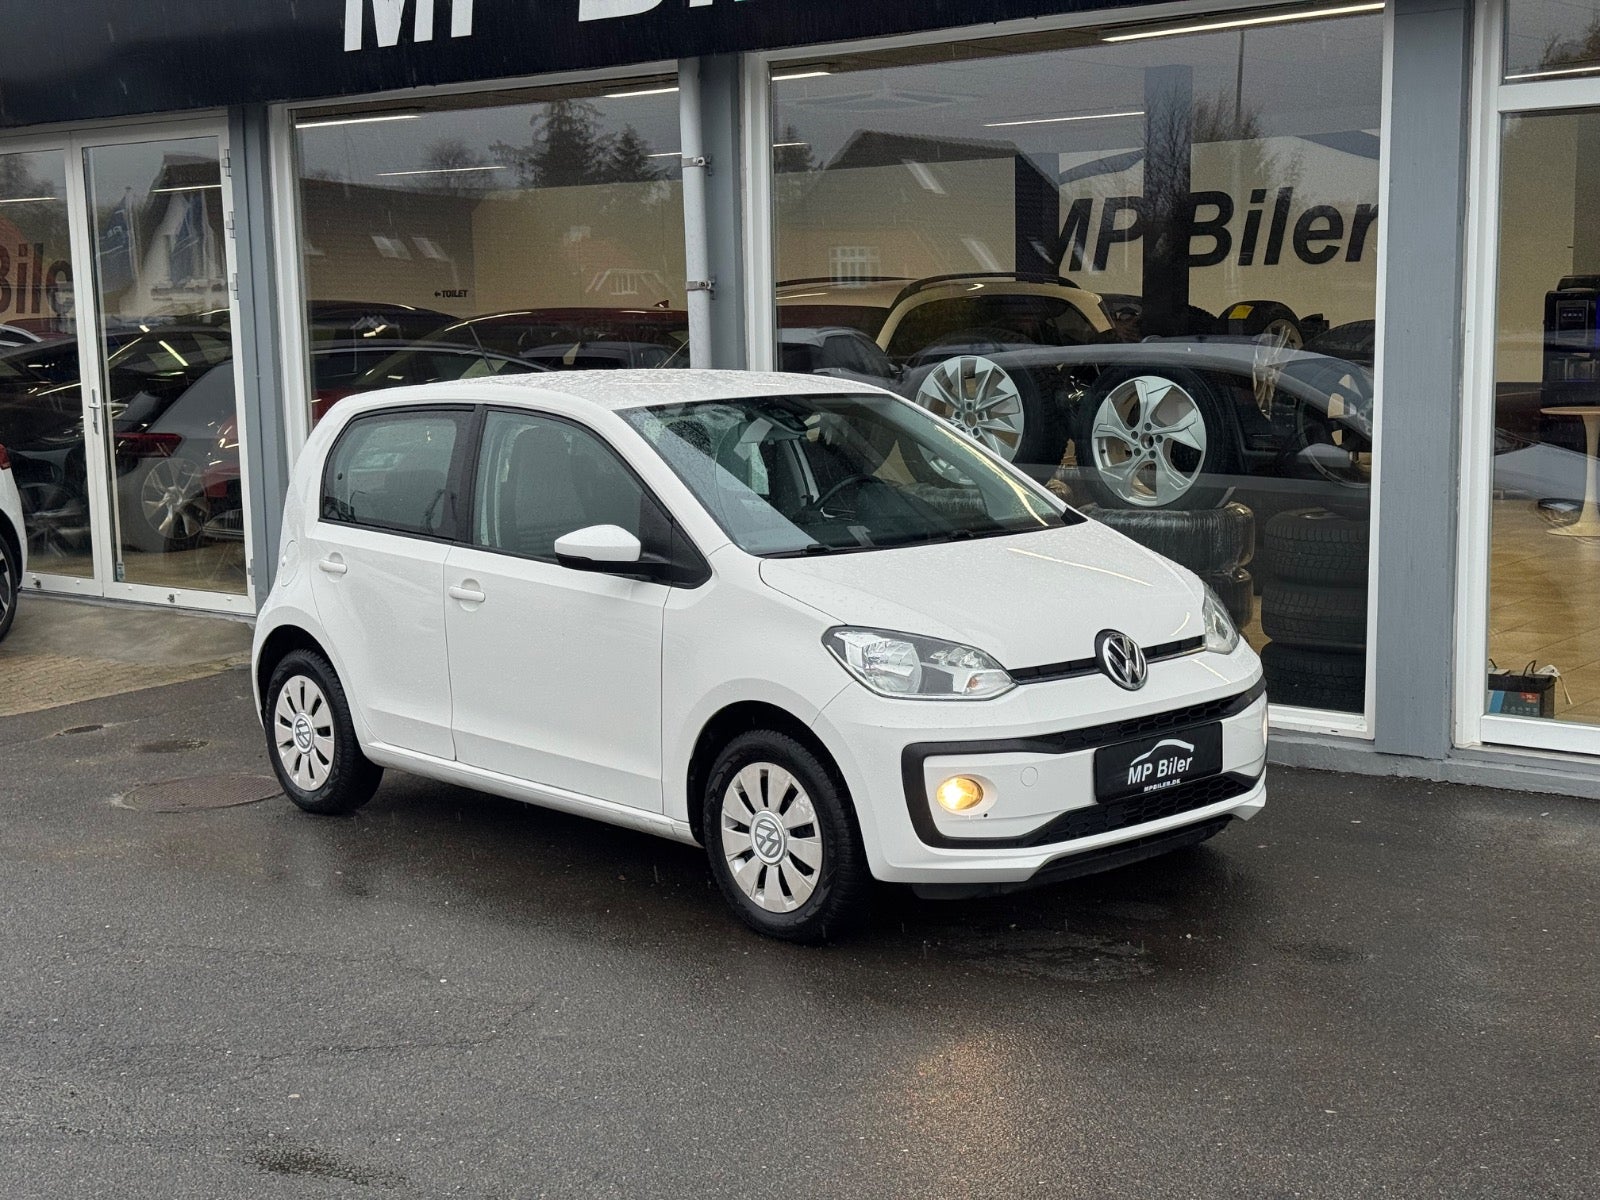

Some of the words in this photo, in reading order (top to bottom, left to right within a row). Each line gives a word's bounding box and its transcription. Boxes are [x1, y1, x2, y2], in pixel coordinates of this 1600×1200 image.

[1189, 187, 1378, 267] Biler
[441, 290, 468, 298] TOILET
[1127, 762, 1153, 785] MP
[1157, 756, 1193, 778] Biler
